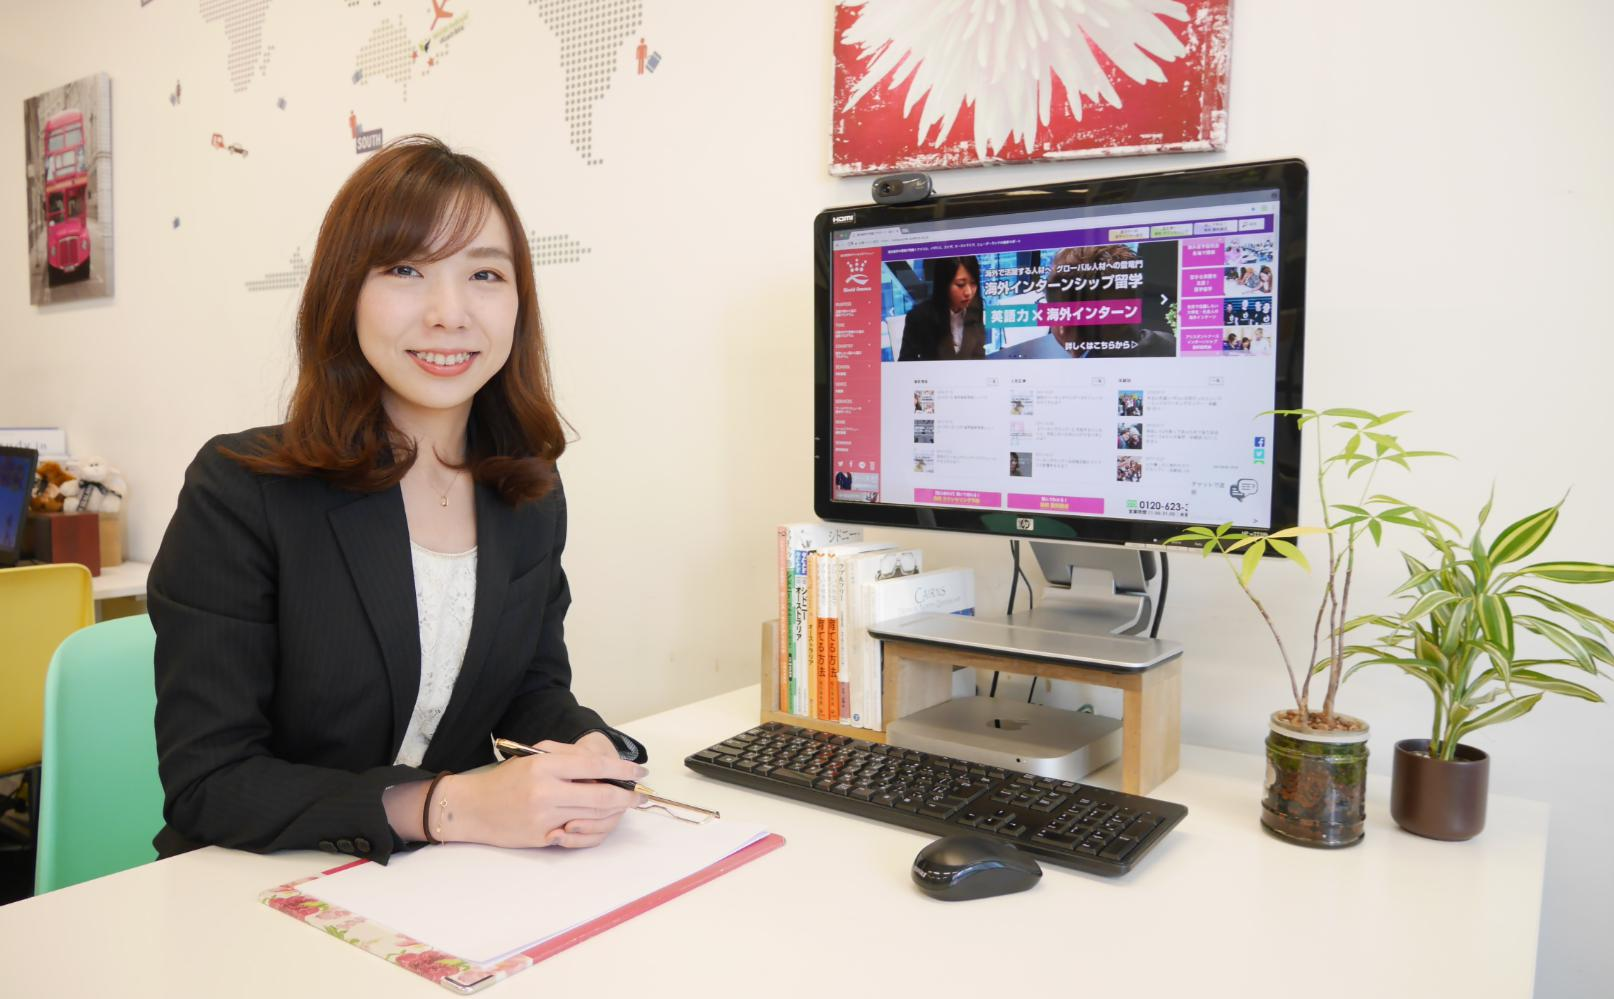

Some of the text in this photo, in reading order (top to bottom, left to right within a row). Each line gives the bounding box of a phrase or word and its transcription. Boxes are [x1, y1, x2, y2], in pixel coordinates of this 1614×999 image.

[357, 134, 381, 150] SOUTH
[832, 214, 854, 224] HDMI
[985, 273, 1144, 296] 海外インターンシップ留学
[991, 309, 1029, 323] 英語力
[1046, 305, 1138, 322] 海外インターン
[1064, 340, 1130, 351] 詳しくはこちらから
